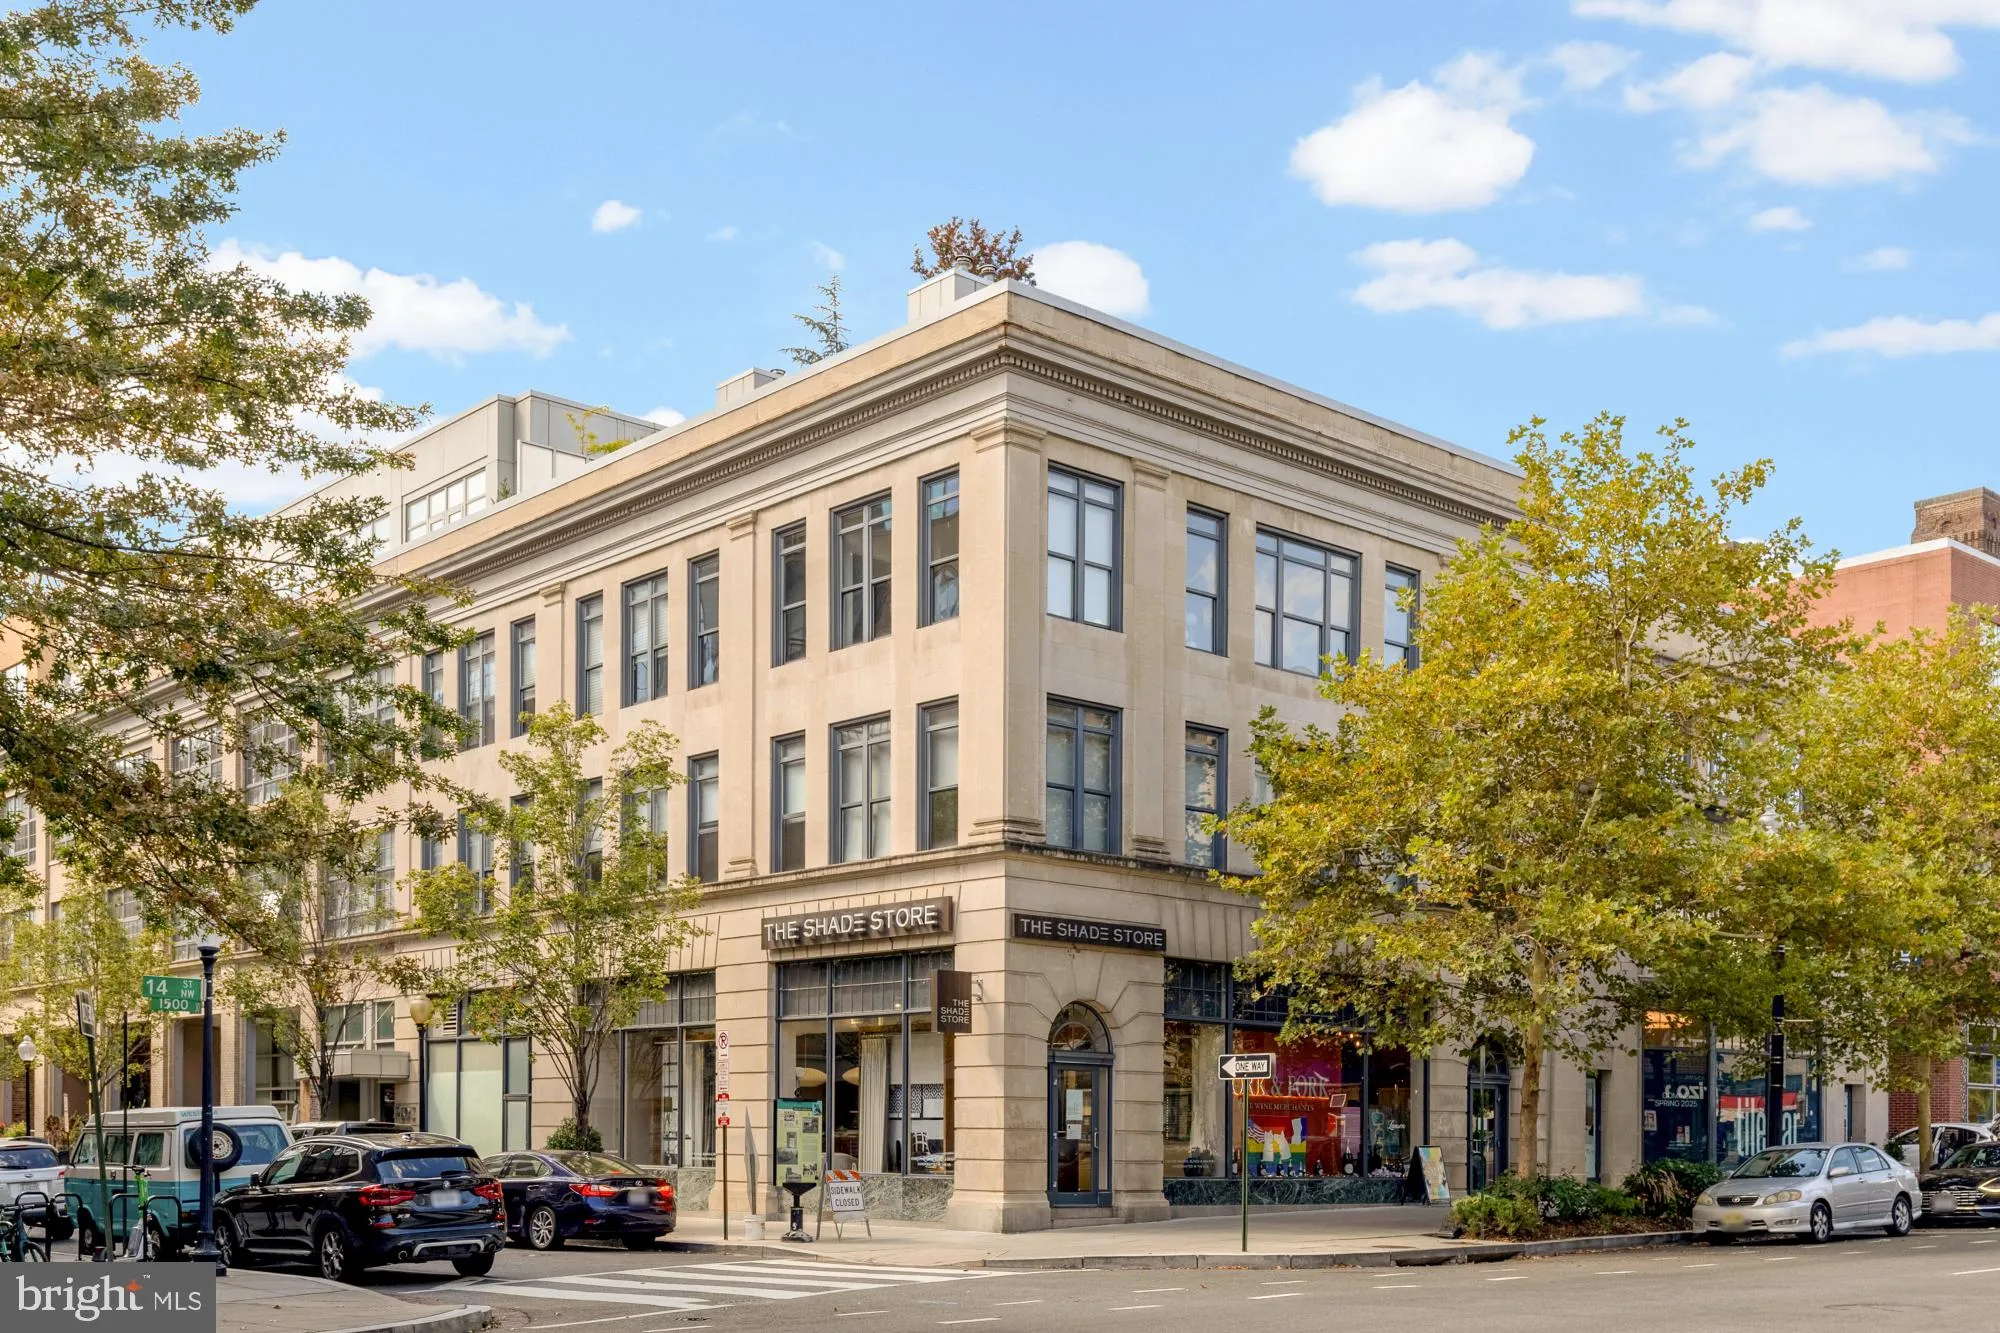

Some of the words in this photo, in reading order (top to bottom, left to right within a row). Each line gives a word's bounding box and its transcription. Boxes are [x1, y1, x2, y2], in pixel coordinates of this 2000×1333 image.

[764, 921, 799, 942] THE
[803, 913, 866, 937] SHADE
[870, 905, 937, 930] STORE
[1020, 919, 1052, 935] THE
[1057, 923, 1109, 940] SHADE
[1113, 929, 1163, 946] STORE
[146, 979, 168, 995] 14
[183, 980, 193, 988] ST
[181, 990, 195, 998] NW
[159, 999, 189, 1010] 1500
[952, 999, 970, 1008] THE
[941, 1007, 970, 1016] SHADE
[941, 1015, 970, 1024] STORE
[1235, 1062, 1249, 1072] ONE
[1252, 1061, 1266, 1070] WAY
[1288, 1075, 1330, 1097] FORK
[831, 1185, 863, 1194] SIDEWALK
[835, 1198, 860, 1207] CLOSED
